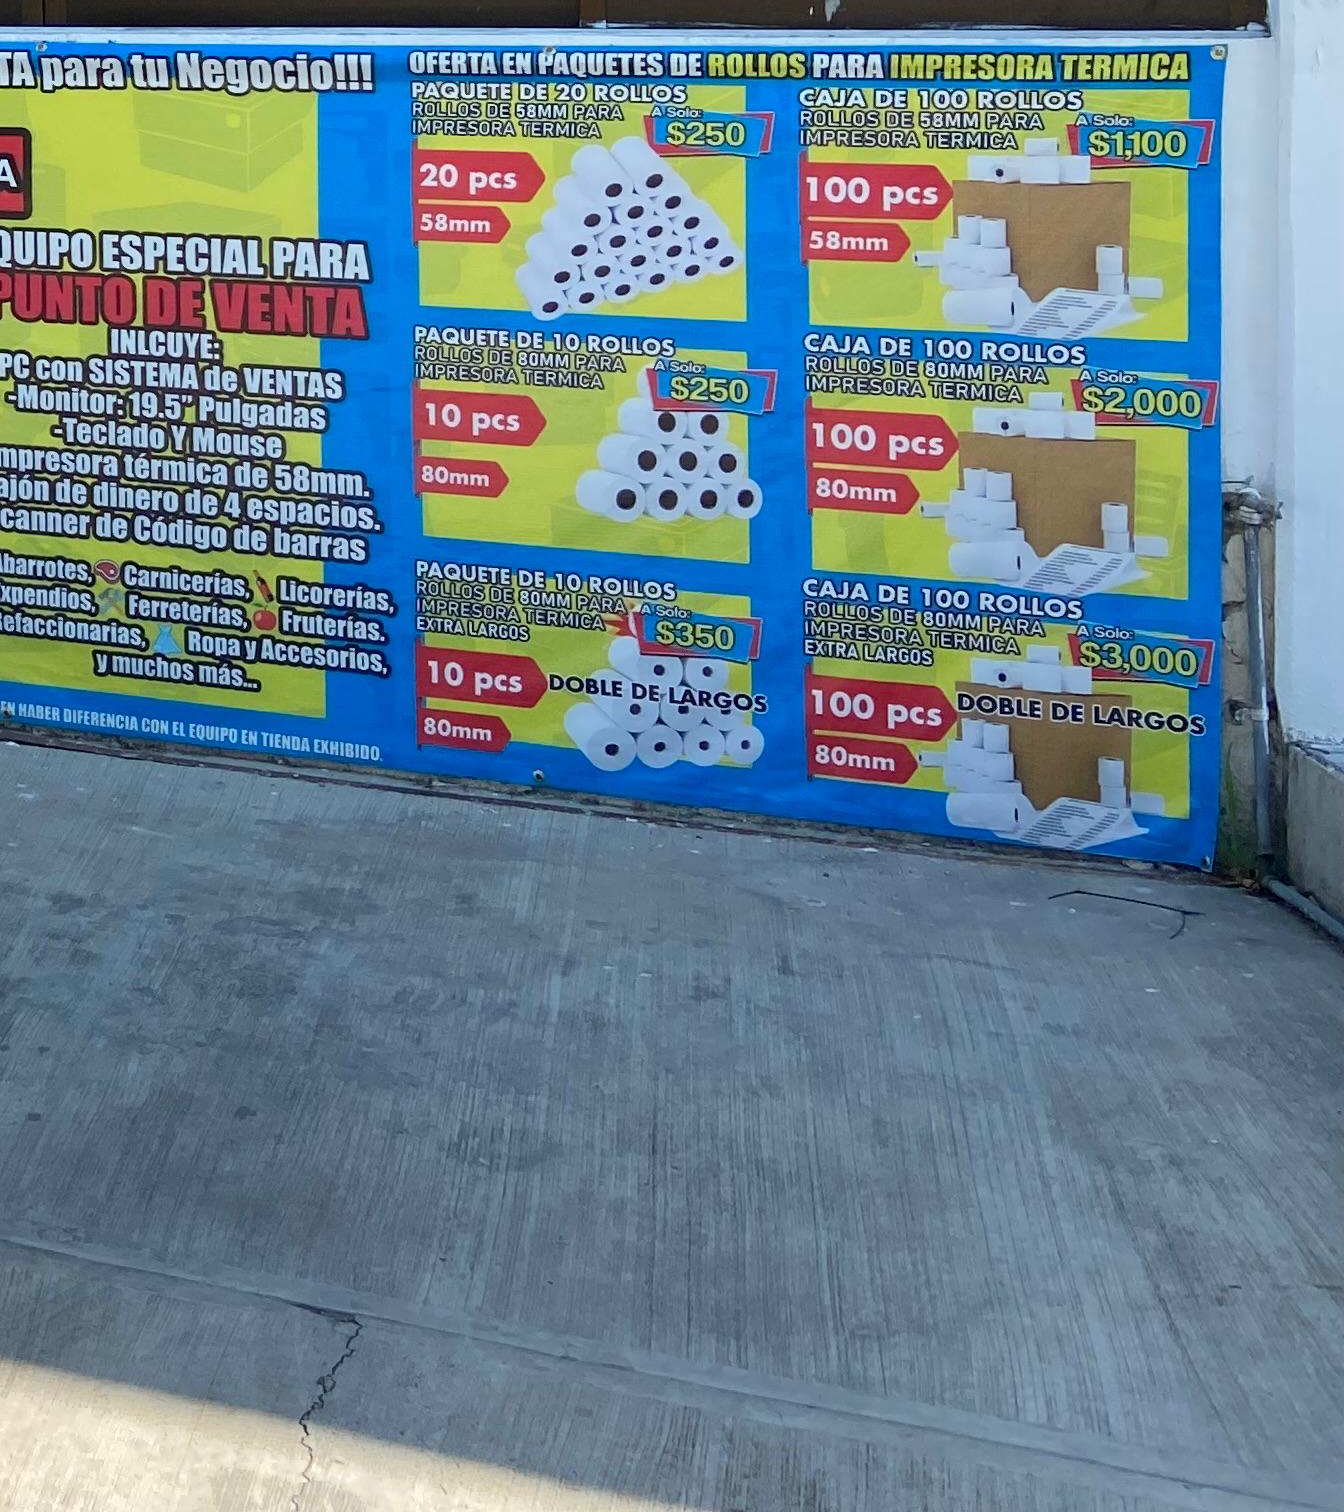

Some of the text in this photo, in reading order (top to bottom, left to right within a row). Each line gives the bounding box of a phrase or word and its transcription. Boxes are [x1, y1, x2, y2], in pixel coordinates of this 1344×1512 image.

[41, 53, 128, 92] para
[129, 52, 169, 88] tu
[177, 52, 374, 95] Negocio!!!
[409, 52, 1190, 80] OFERTA EN PAQUETES DE ROLLOS PARA IMPRESORA TERMICA
[412, 82, 687, 103] PAQUETE DE 20 ROLLOS
[666, 122, 746, 146] $250
[1087, 130, 1187, 160] $1,100
[419, 164, 518, 193] 20 pcs
[805, 177, 939, 211] 100 pcs
[420, 214, 491, 233] 58mm
[101, 232, 267, 276] ESPECIAL
[273, 239, 370, 281] PARA
[809, 231, 889, 252] 58mm
[144, 276, 205, 328] DE
[214, 282, 369, 338] VENTA
[109, 329, 221, 361] INLCUYE:
[35, 356, 83, 382] con
[88, 358, 199, 389] SISTEMA
[204, 365, 237, 391] de
[243, 367, 343, 400] VENTAS
[7, 386, 123, 416] -Monitor:
[199, 398, 327, 431] Pulgadas
[123, 565, 251, 599] Carnicerías,
[279, 579, 396, 613] Licorerías,
[1080, 641, 1197, 677] $3,000
[957, 692, 1207, 736] DOBLE DE LARGOS
